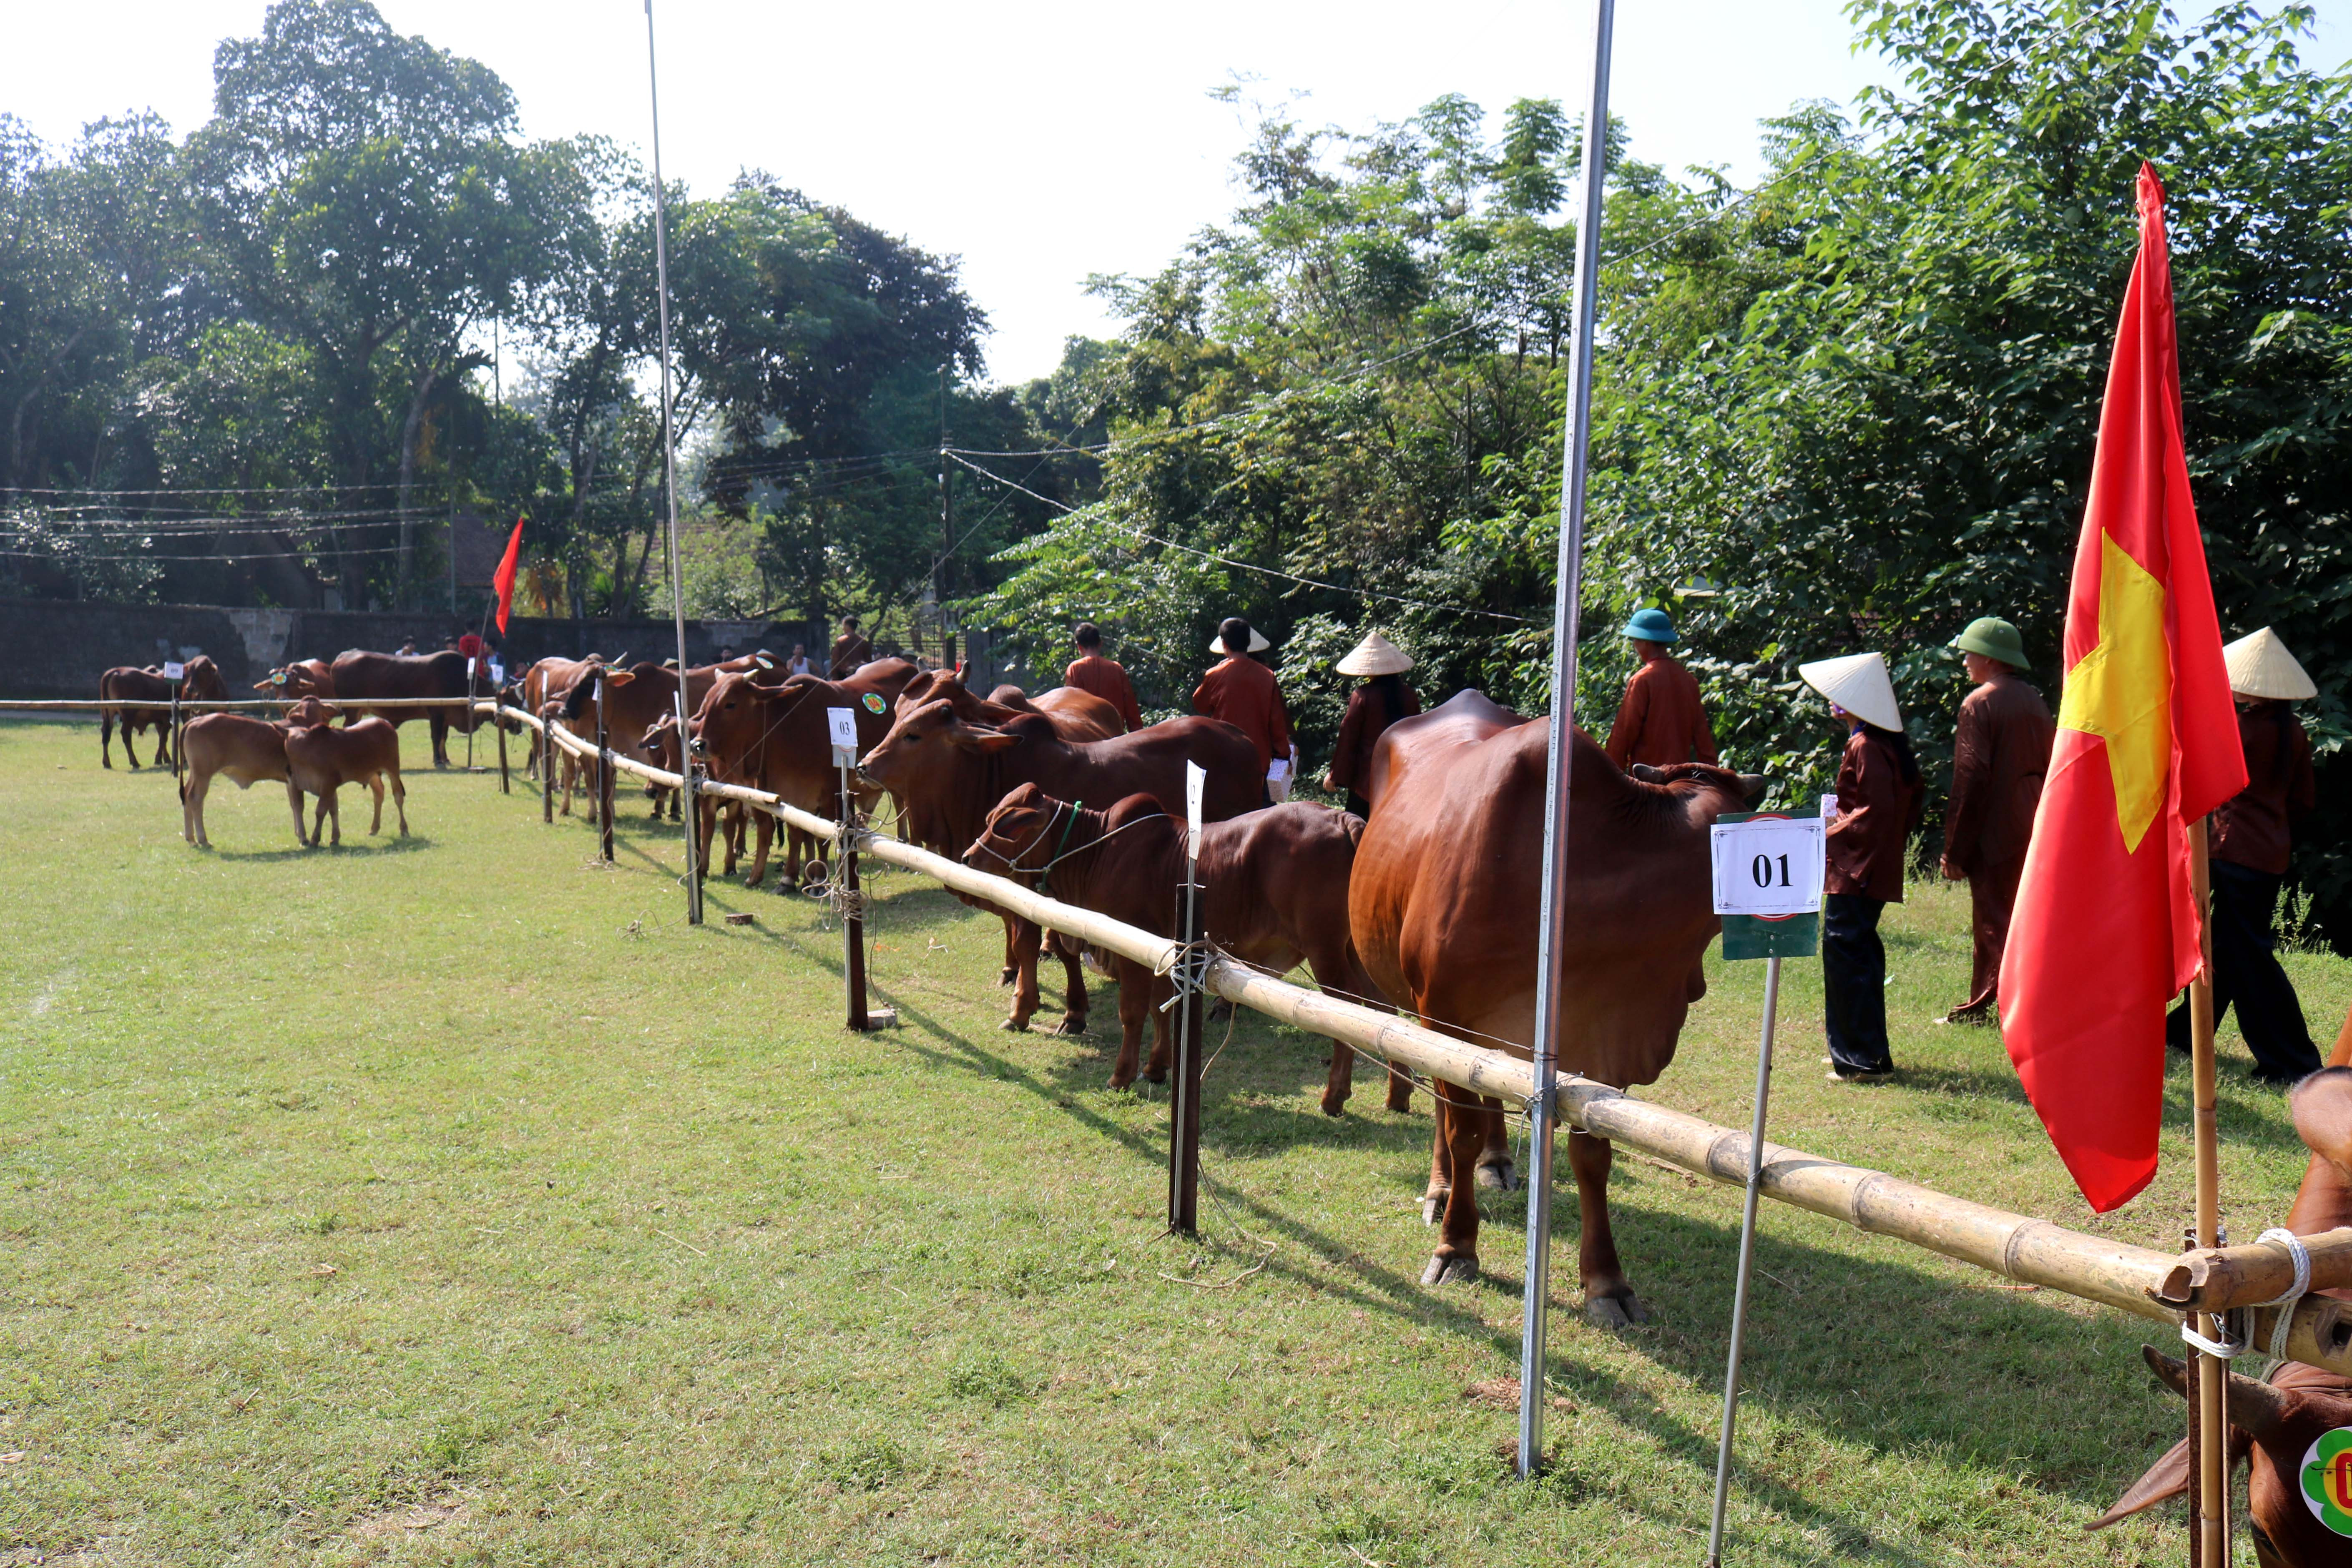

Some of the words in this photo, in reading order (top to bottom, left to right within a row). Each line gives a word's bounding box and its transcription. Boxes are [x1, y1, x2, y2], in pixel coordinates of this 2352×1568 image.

[867, 699, 880, 709] 04
[839, 721, 850, 735] 03
[1753, 854, 1793, 888] 01
